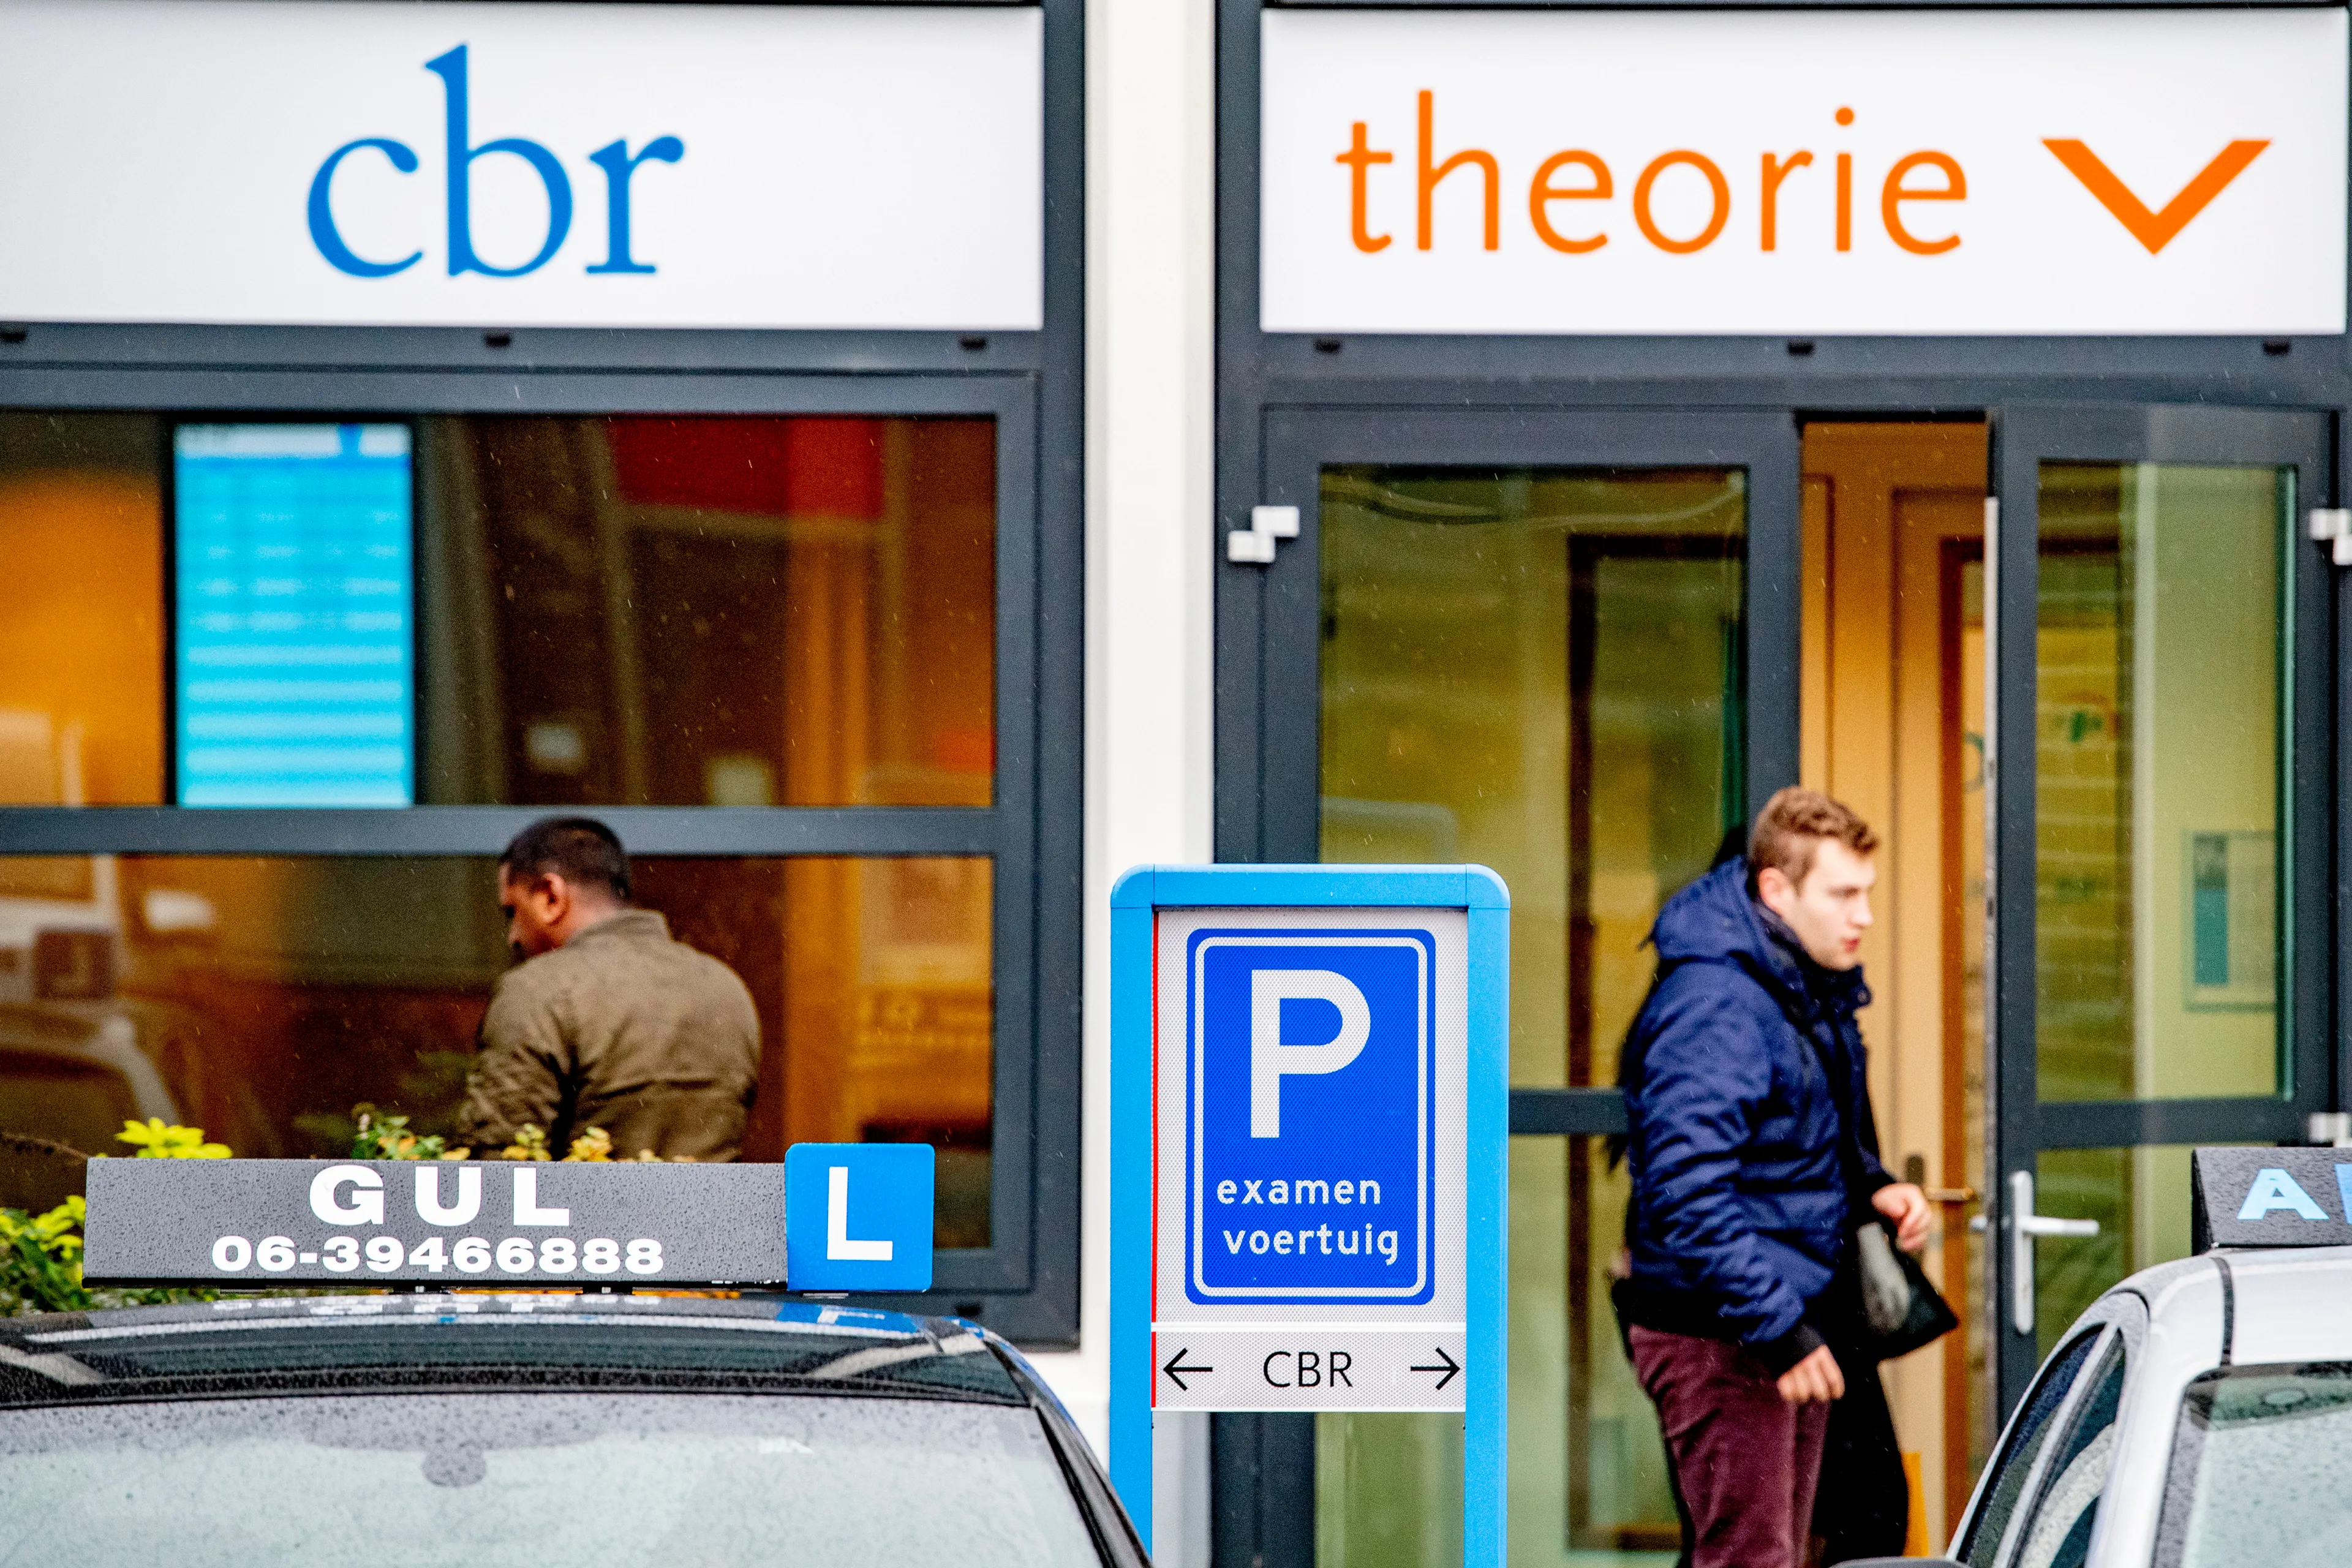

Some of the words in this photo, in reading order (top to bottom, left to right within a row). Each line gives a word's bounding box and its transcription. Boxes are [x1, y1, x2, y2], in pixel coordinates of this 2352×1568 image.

[306, 43, 686, 279] cbr
[1335, 89, 1967, 255] theorie
[1250, 968, 1371, 1139] P
[309, 1164, 570, 1226] GUL
[827, 1167, 893, 1261] L
[1216, 1180, 1381, 1204] examen
[2236, 1163, 2352, 1224] A
[211, 1235, 665, 1275] 06-39466888
[1223, 1223, 1398, 1265] voertuig
[1263, 1351, 1353, 1388] CBR
